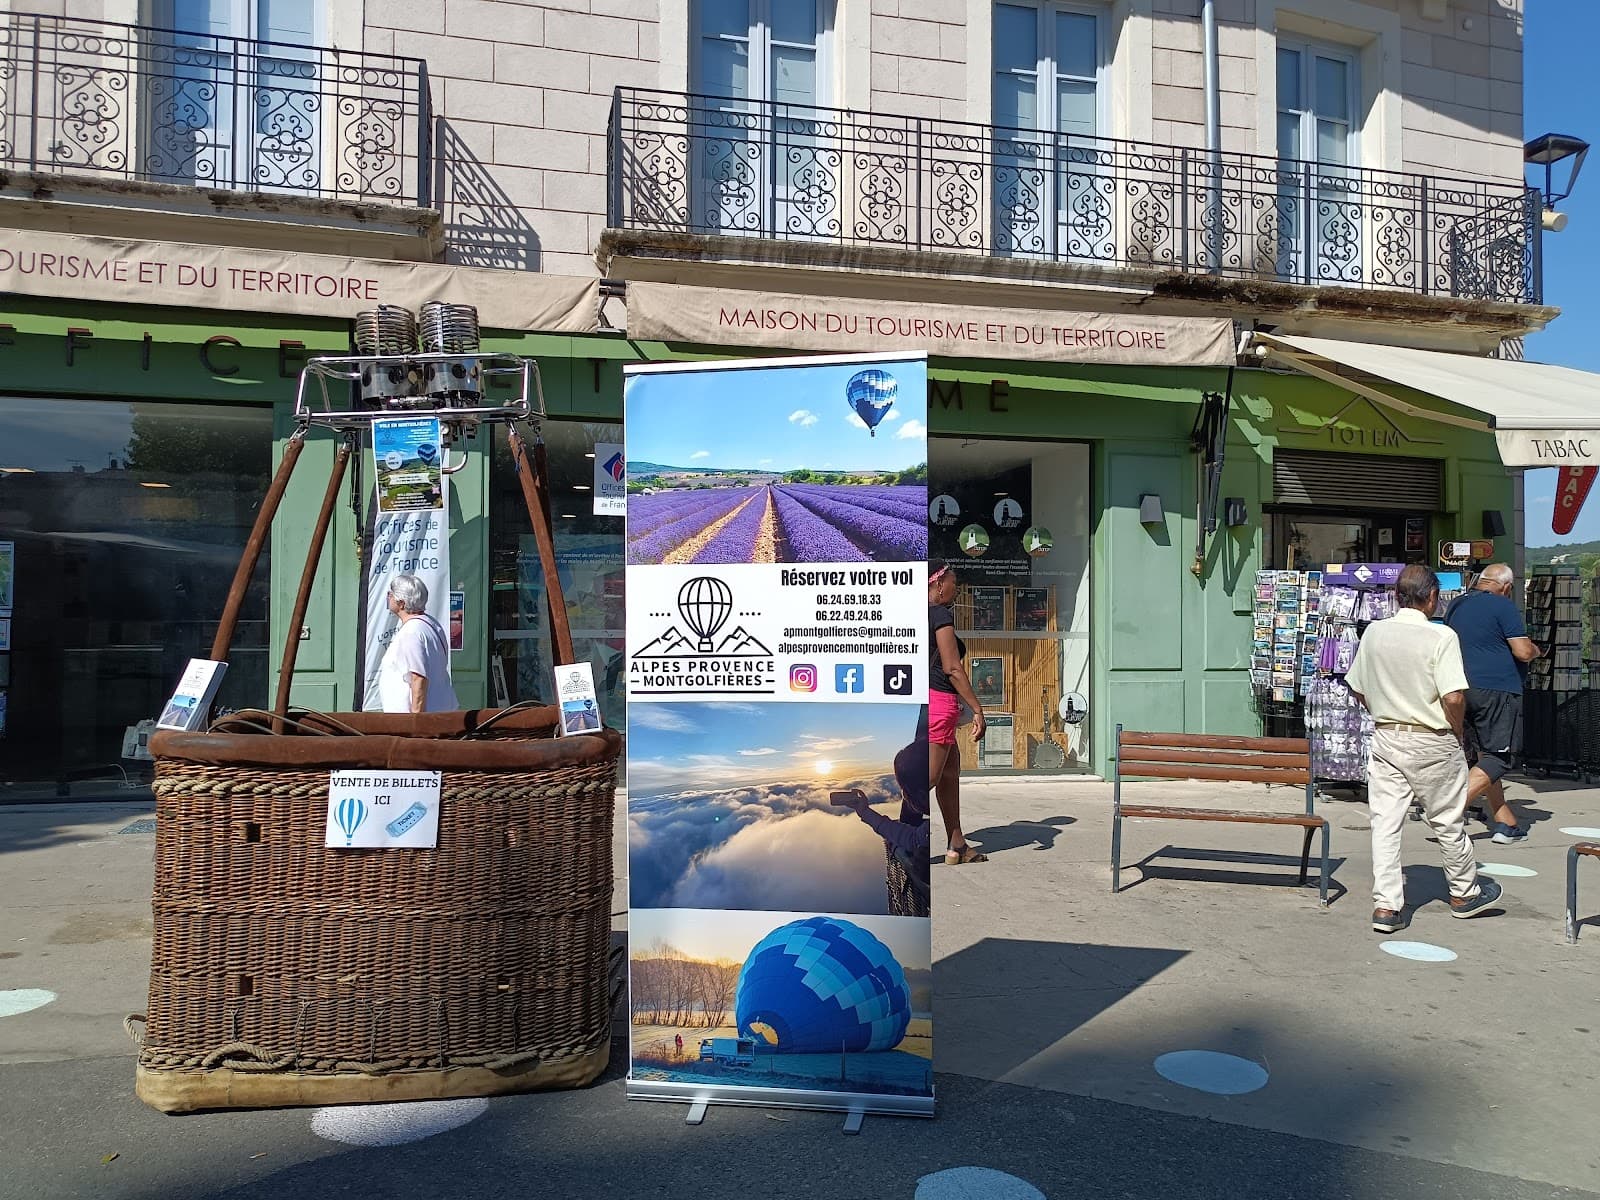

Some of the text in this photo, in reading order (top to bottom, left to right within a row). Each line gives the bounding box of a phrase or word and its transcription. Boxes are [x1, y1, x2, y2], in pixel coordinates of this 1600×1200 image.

[138, 262, 168, 284] ET
[178, 264, 217, 288] DU
[227, 268, 379, 300] TERRITOIRE
[719, 308, 1166, 350] MAISON DU TOURISME ET DU TERRITOIRE
[1328, 426, 1400, 449] TOTEM
[1531, 439, 1592, 458] TABAC
[379, 517, 439, 536] Offices de
[378, 537, 439, 556] Tourisme
[374, 556, 439, 575] de France
[781, 568, 913, 586] Réservez votre vol
[816, 594, 882, 606] 06.24.69.18.33
[815, 610, 883, 621] 06.22.49.24.86
[783, 626, 916, 639] apmontgolfieres@gmail.com
[778, 642, 919, 655] alpesprovencemontgolfières.fr
[630, 660, 775, 673] ALPES PROVENCE
[643, 671, 762, 687] MONTGOLFIÈRES
[332, 777, 439, 789] VENTE DE BILLETS
[374, 795, 391, 805] ICI
[397, 811, 415, 826] TICKET
